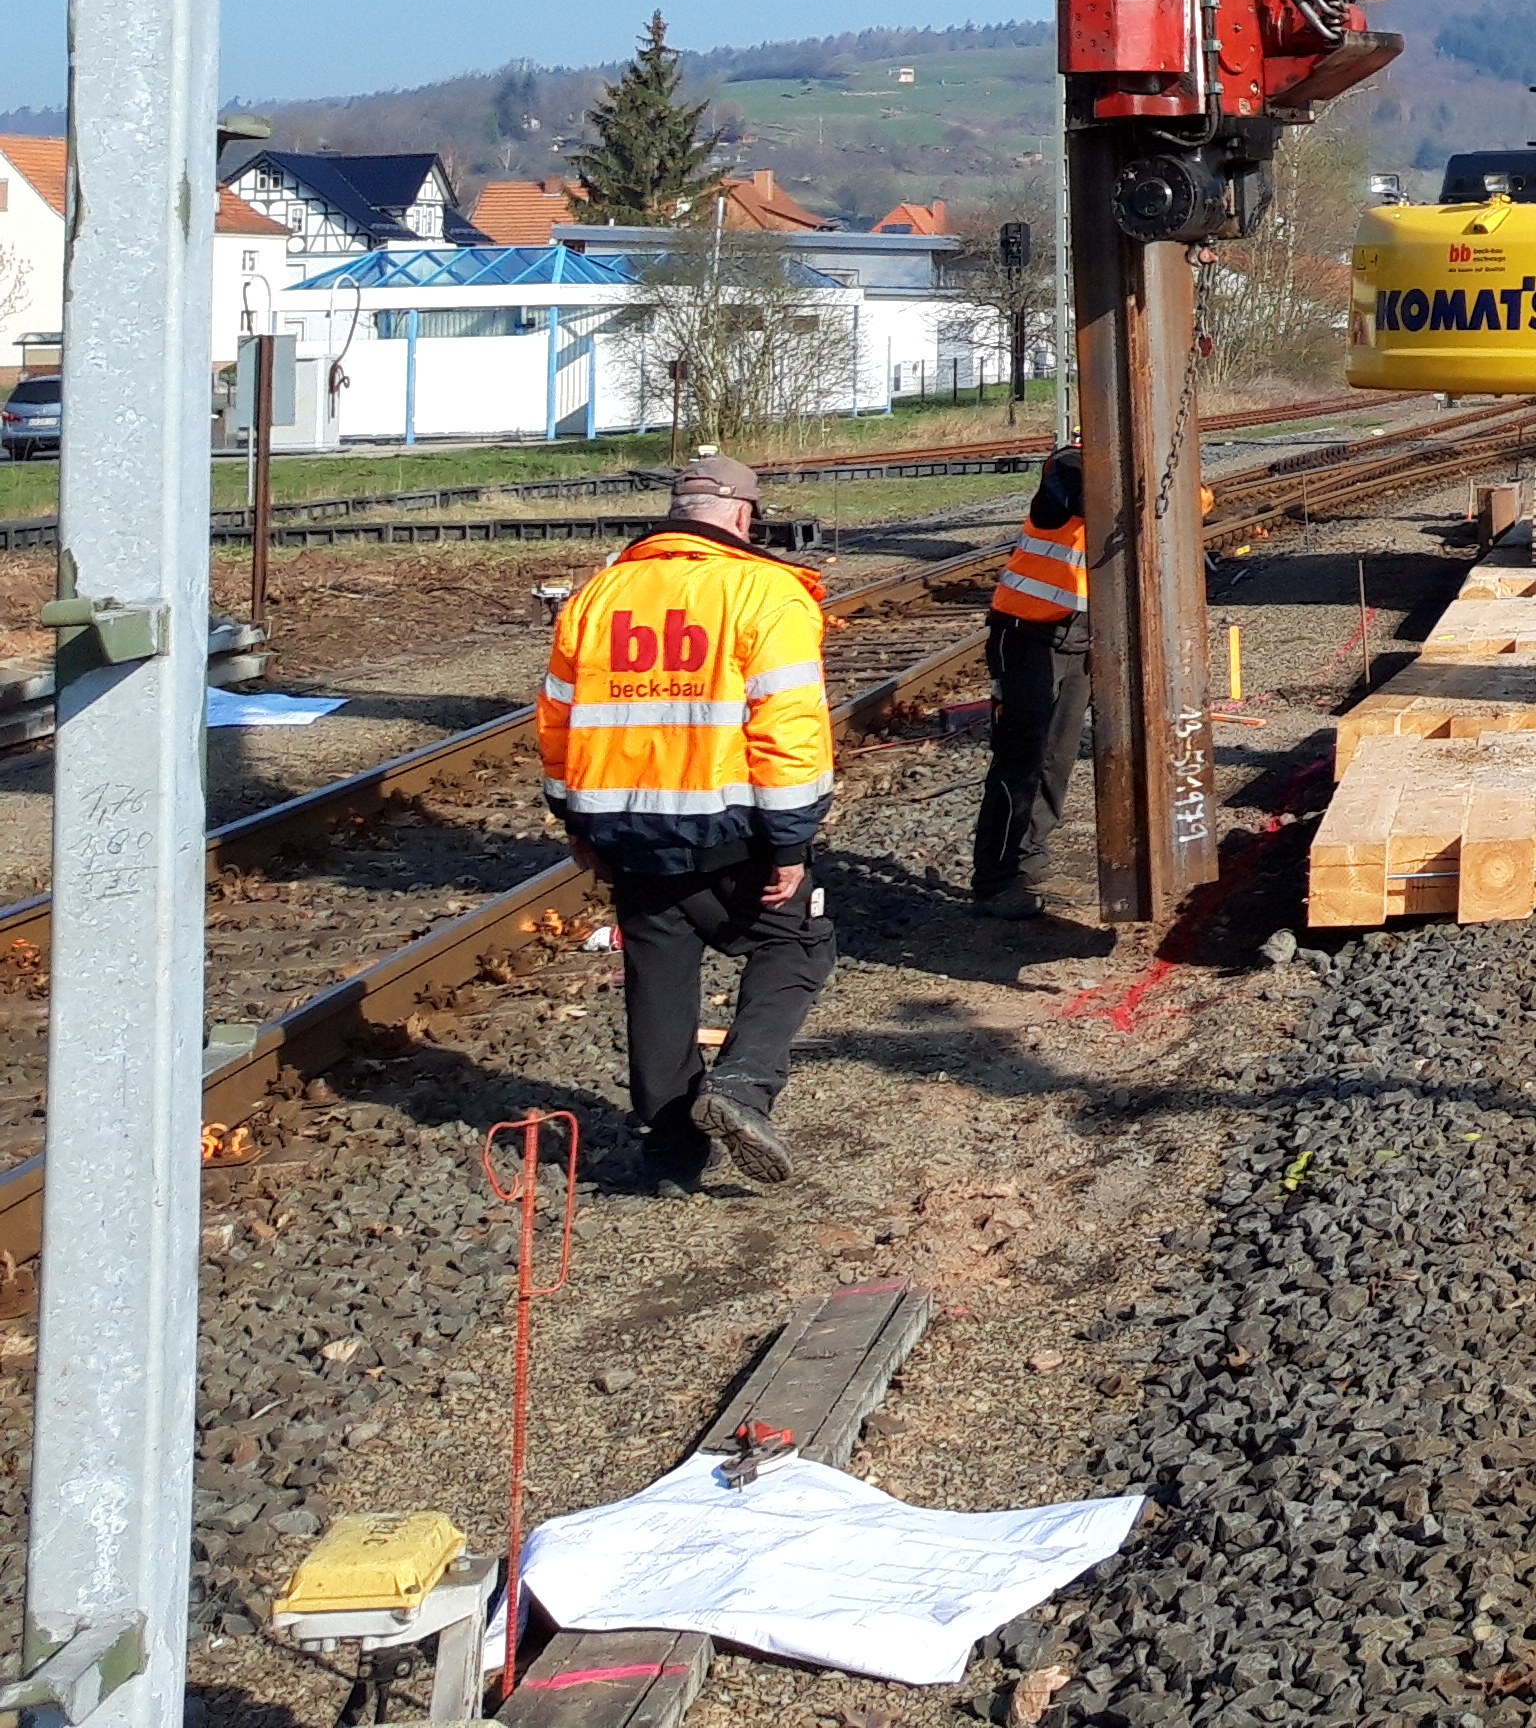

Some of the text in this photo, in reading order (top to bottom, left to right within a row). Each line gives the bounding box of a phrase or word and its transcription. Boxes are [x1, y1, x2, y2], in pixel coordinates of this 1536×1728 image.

[1448, 242, 1472, 263] bb
[610, 608, 710, 673] bb
[609, 678, 705, 699] beck-bau
